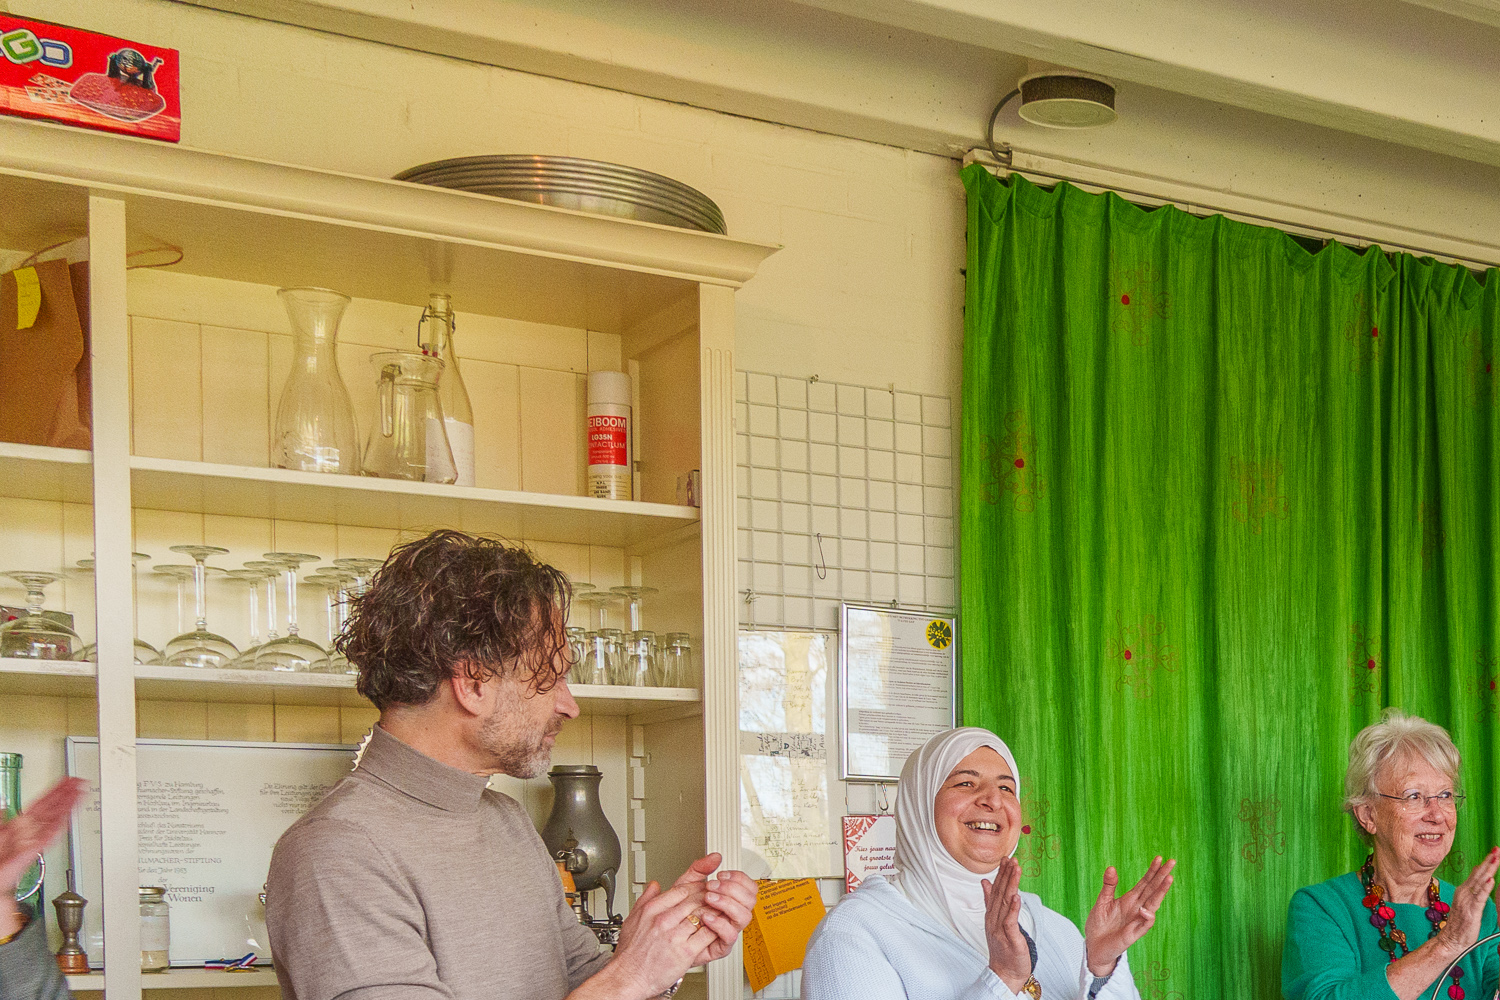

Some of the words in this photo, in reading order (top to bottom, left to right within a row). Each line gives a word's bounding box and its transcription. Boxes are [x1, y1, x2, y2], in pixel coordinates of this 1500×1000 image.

[0, 28, 73, 69] GO
[163, 884, 215, 893] Vereniging
[168, 893, 202, 902] Wonen
